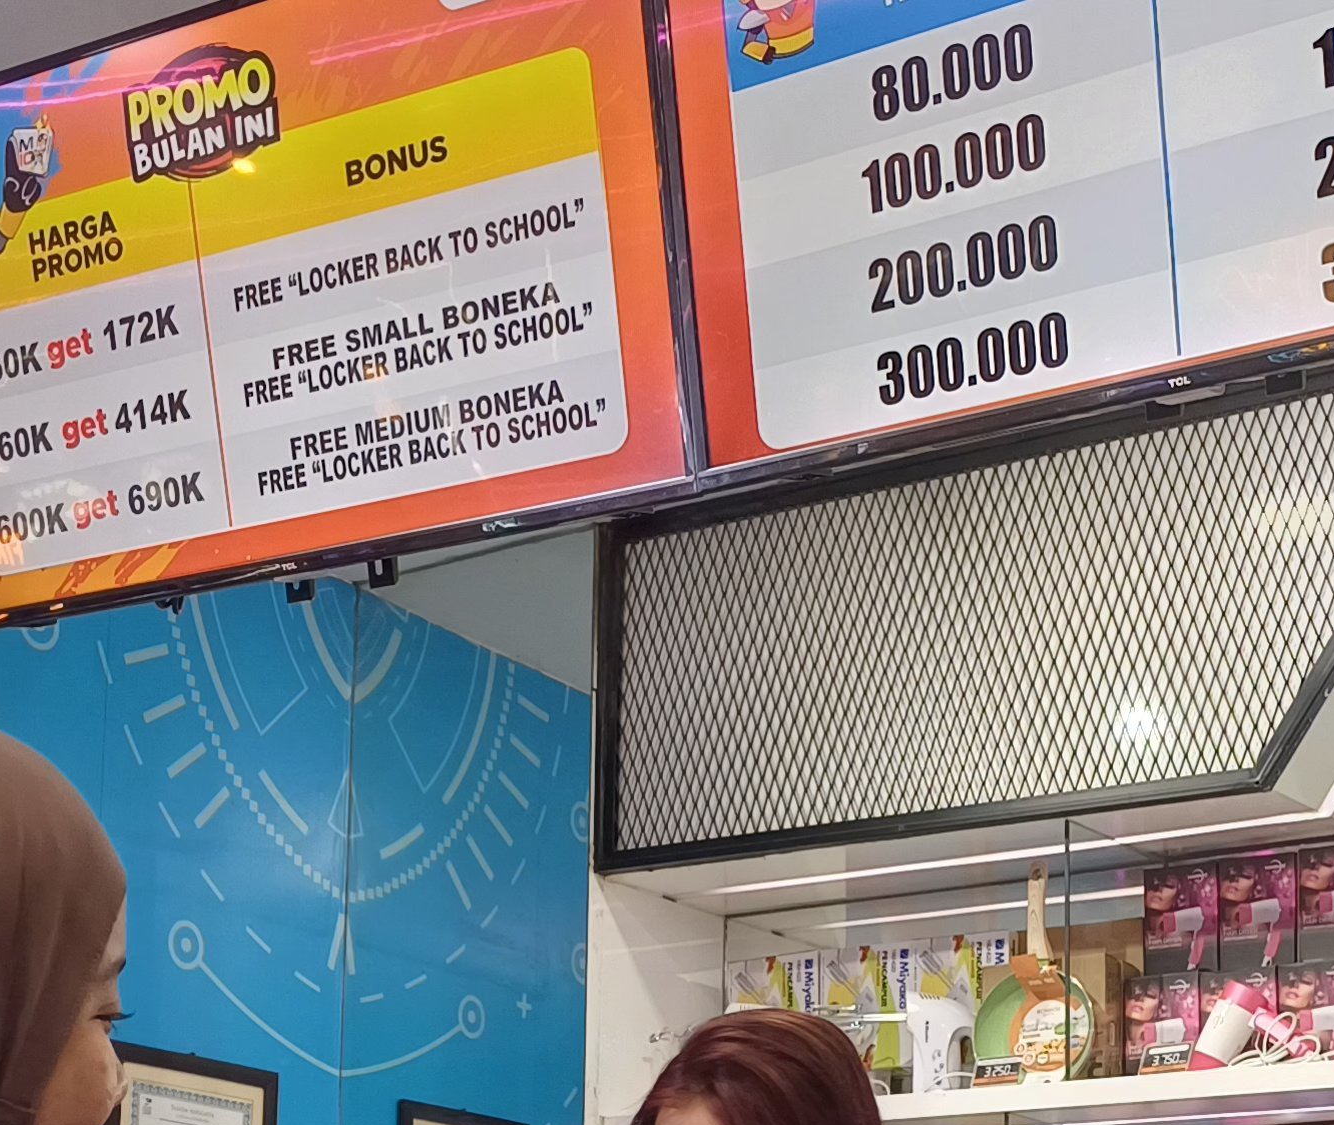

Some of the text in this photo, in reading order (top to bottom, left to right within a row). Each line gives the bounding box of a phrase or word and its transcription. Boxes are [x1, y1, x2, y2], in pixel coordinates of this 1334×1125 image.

[128, 58, 271, 142] PROMO
[871, 23, 1033, 122] 80.000
[133, 107, 275, 178] BULAN INI
[345, 136, 448, 187] BONUS
[861, 113, 1046, 214] 100.000
[28, 210, 117, 255] HARGA
[32, 237, 123, 282] PROMO
[868, 214, 1058, 314] 200.000
[234, 277, 283, 312] FREE
[385, 236, 443, 274] BACK
[449, 227, 478, 257] TO
[46, 328, 94, 369] get
[103, 304, 179, 350] 172K
[272, 282, 560, 369] FREE SMALL BONEKA
[877, 311, 1068, 406] 300.000
[243, 374, 293, 407] FREE
[395, 335, 453, 373] BACK
[458, 328, 487, 357] TO
[1167, 376, 1191, 389] TCL
[61, 408, 109, 449] get
[115, 389, 191, 433] 414K
[290, 379, 564, 461] FREE MEDIUM BONEKA
[257, 463, 307, 496] FREE
[409, 429, 466, 465] BACK
[471, 420, 501, 451] TO
[73, 490, 119, 529] get
[128, 471, 204, 515] 690K
[280, 562, 298, 571] TCL
[897, 961, 908, 1009] Miyako
